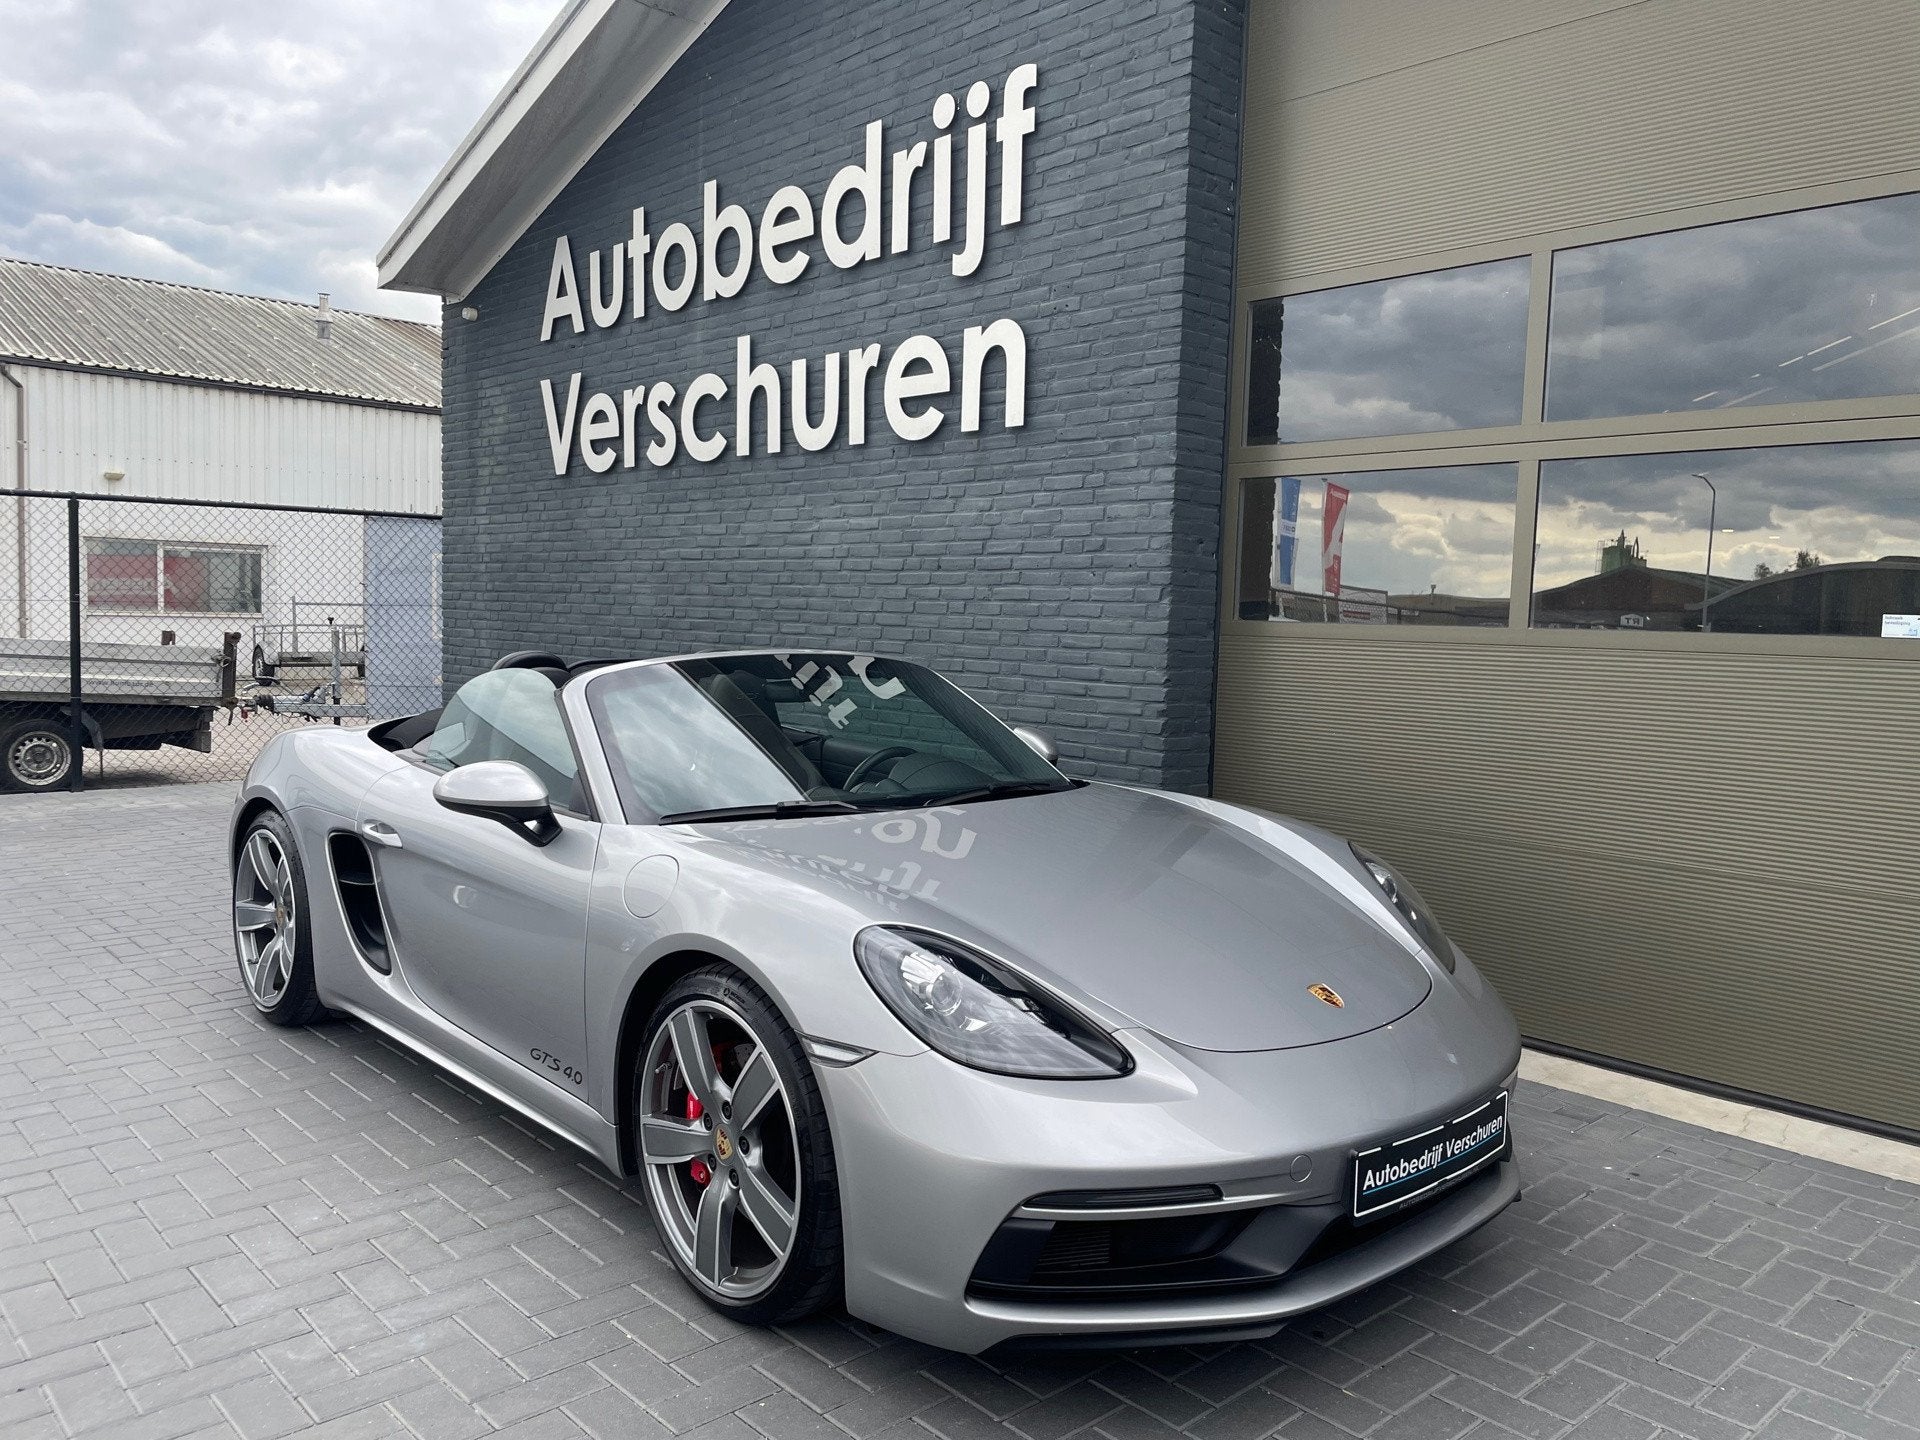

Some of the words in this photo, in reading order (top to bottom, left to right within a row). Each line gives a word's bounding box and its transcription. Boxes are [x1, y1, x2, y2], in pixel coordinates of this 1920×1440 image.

[540, 63, 1037, 342] Autobedrijf
[540, 318, 1027, 475] Verschuren
[530, 1047, 561, 1072] GTS
[563, 1066, 583, 1085] 4.0
[1363, 1143, 1443, 1191] Autobedrijf
[1446, 1115, 1503, 1158] Verschuren
